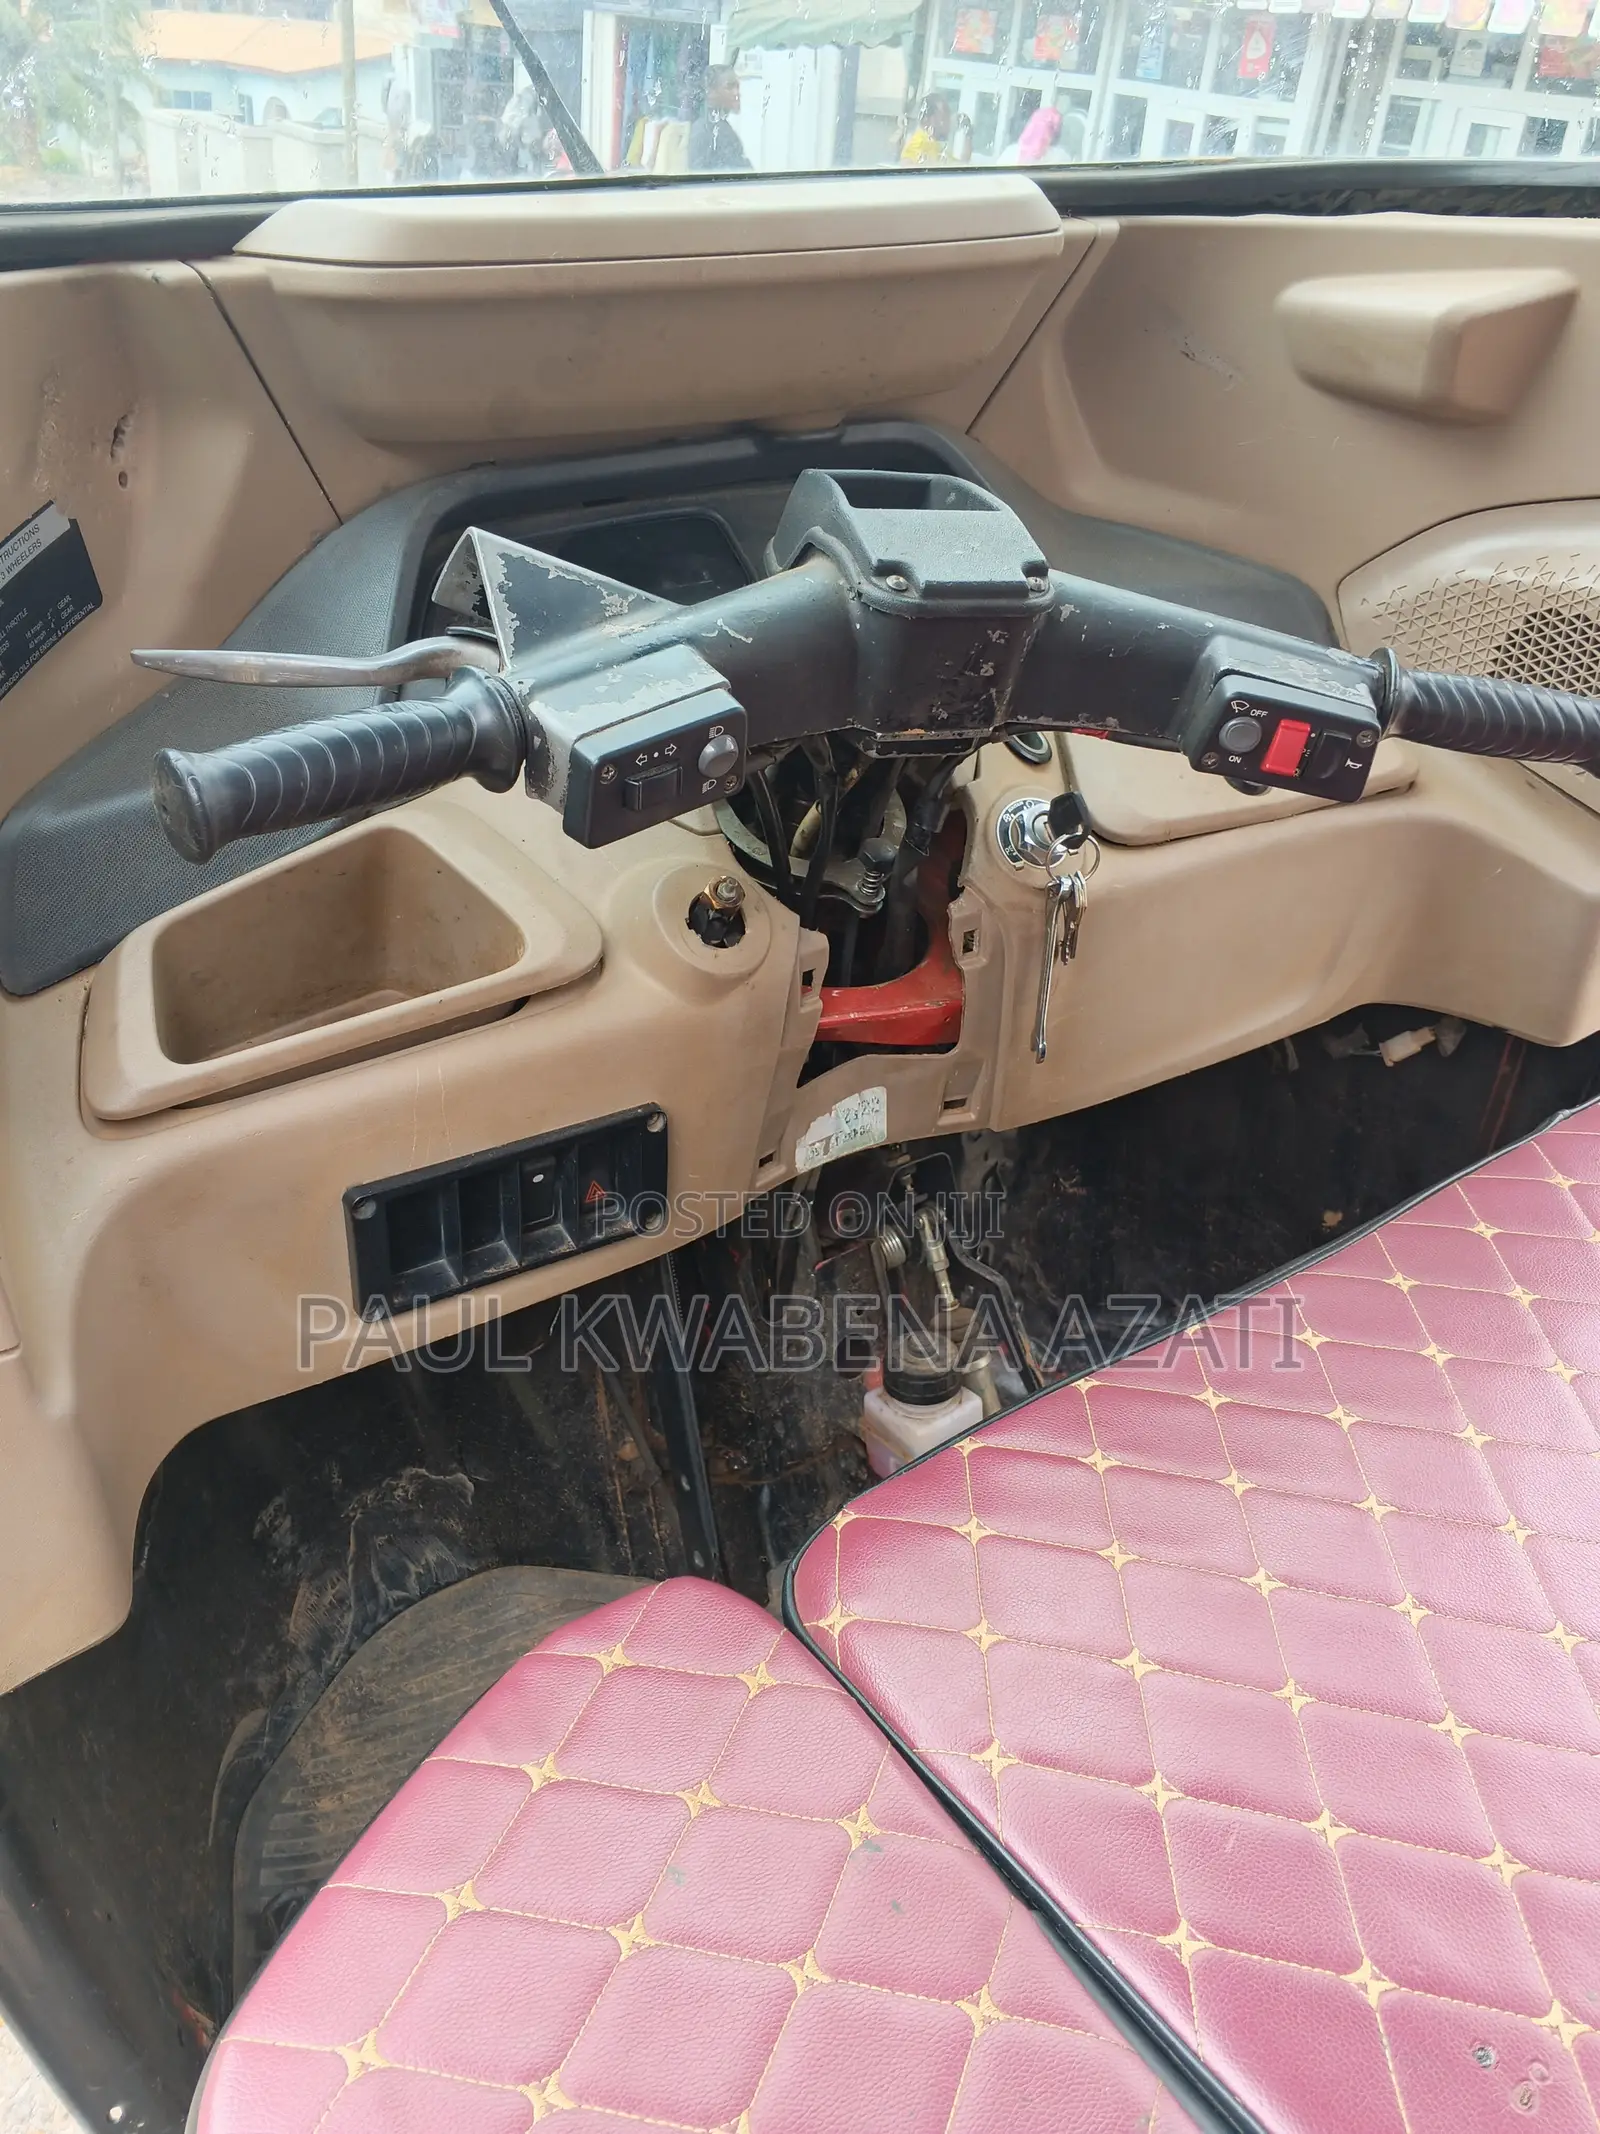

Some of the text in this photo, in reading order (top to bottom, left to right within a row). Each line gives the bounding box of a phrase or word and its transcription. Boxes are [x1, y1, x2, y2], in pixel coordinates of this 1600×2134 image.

[0, 523, 40, 565] TRUCTIONS
[5, 538, 42, 574] WHEELERS
[57, 594, 72, 610] GEAR
[5, 607, 29, 633] THROTTLE
[30, 650, 41, 664] FOR
[61, 601, 95, 633] DIFFERENTIAL
[1250, 708, 1268, 718] OFF
[1228, 755, 1242, 764] ON
